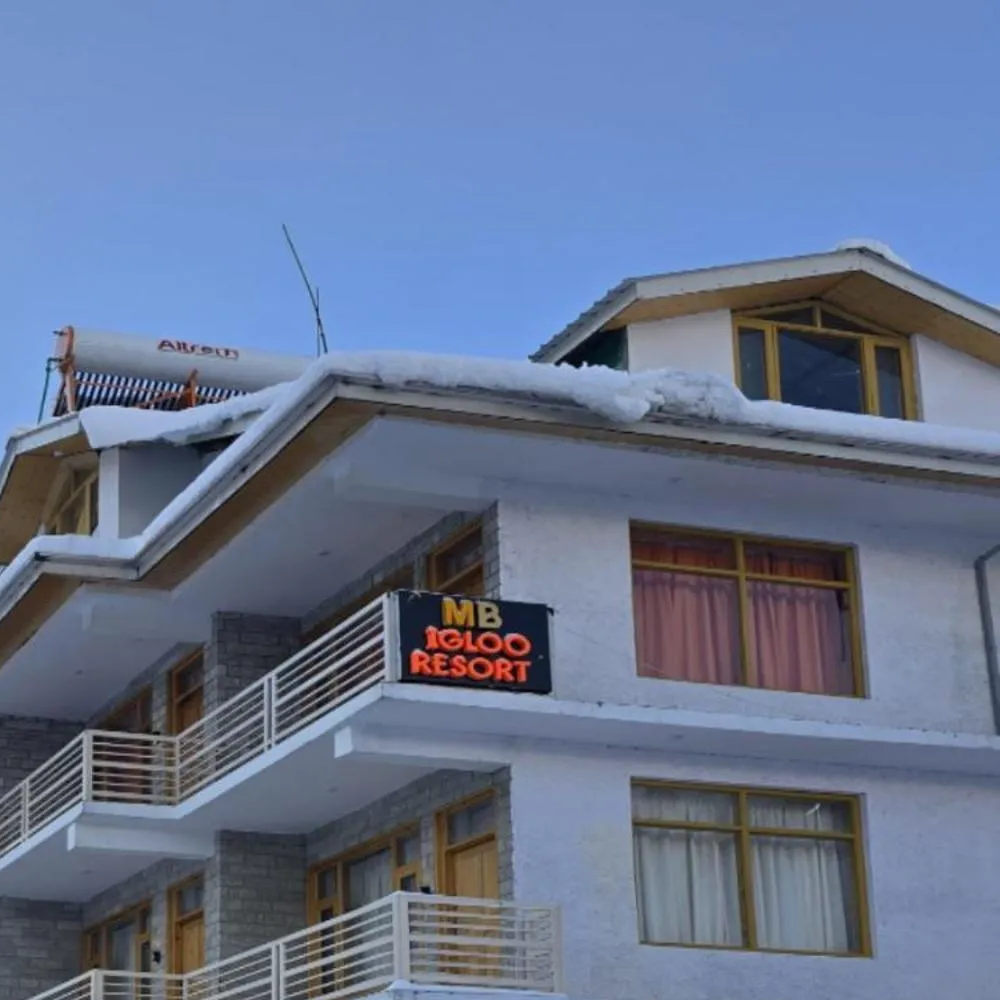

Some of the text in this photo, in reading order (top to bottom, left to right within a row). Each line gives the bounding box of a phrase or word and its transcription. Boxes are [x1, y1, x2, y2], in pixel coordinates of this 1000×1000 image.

[441, 596, 503, 629] MB
[424, 625, 532, 658] IGLOO
[409, 649, 532, 683] RESORT
